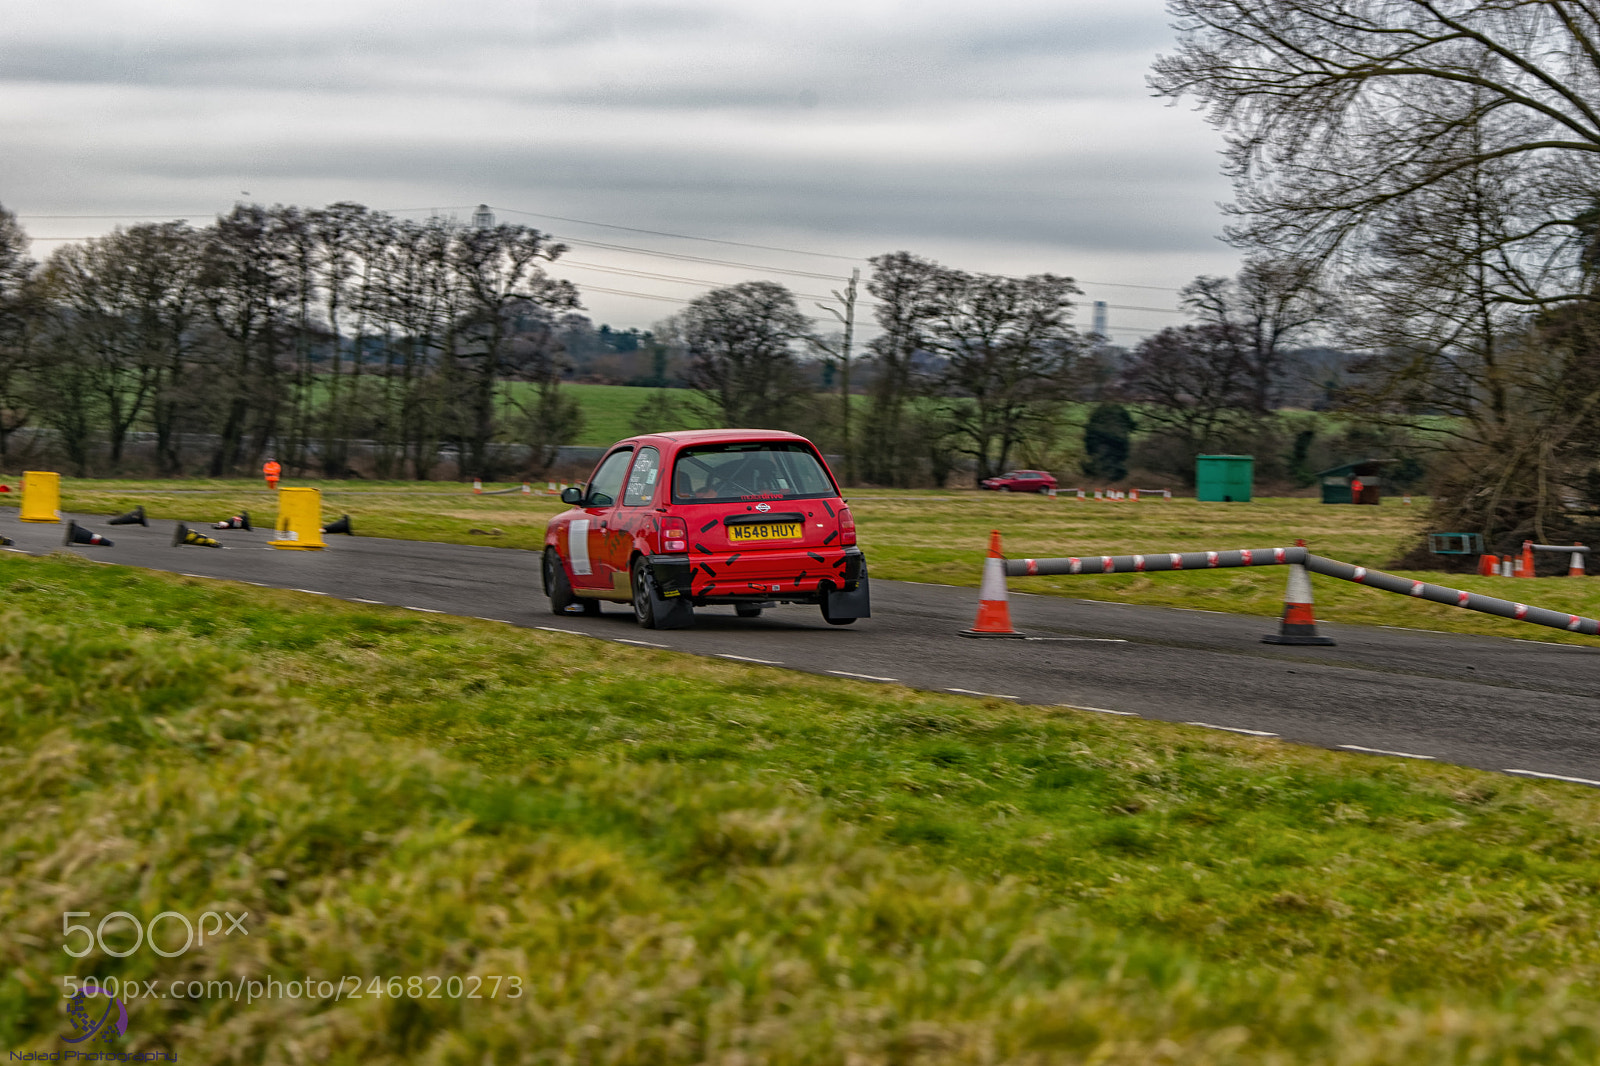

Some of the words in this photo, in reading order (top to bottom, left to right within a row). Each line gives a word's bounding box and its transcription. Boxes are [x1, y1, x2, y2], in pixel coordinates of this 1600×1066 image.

[741, 492, 784, 500] motordrive
[734, 526, 768, 538] M548
[771, 524, 796, 537] HUY
